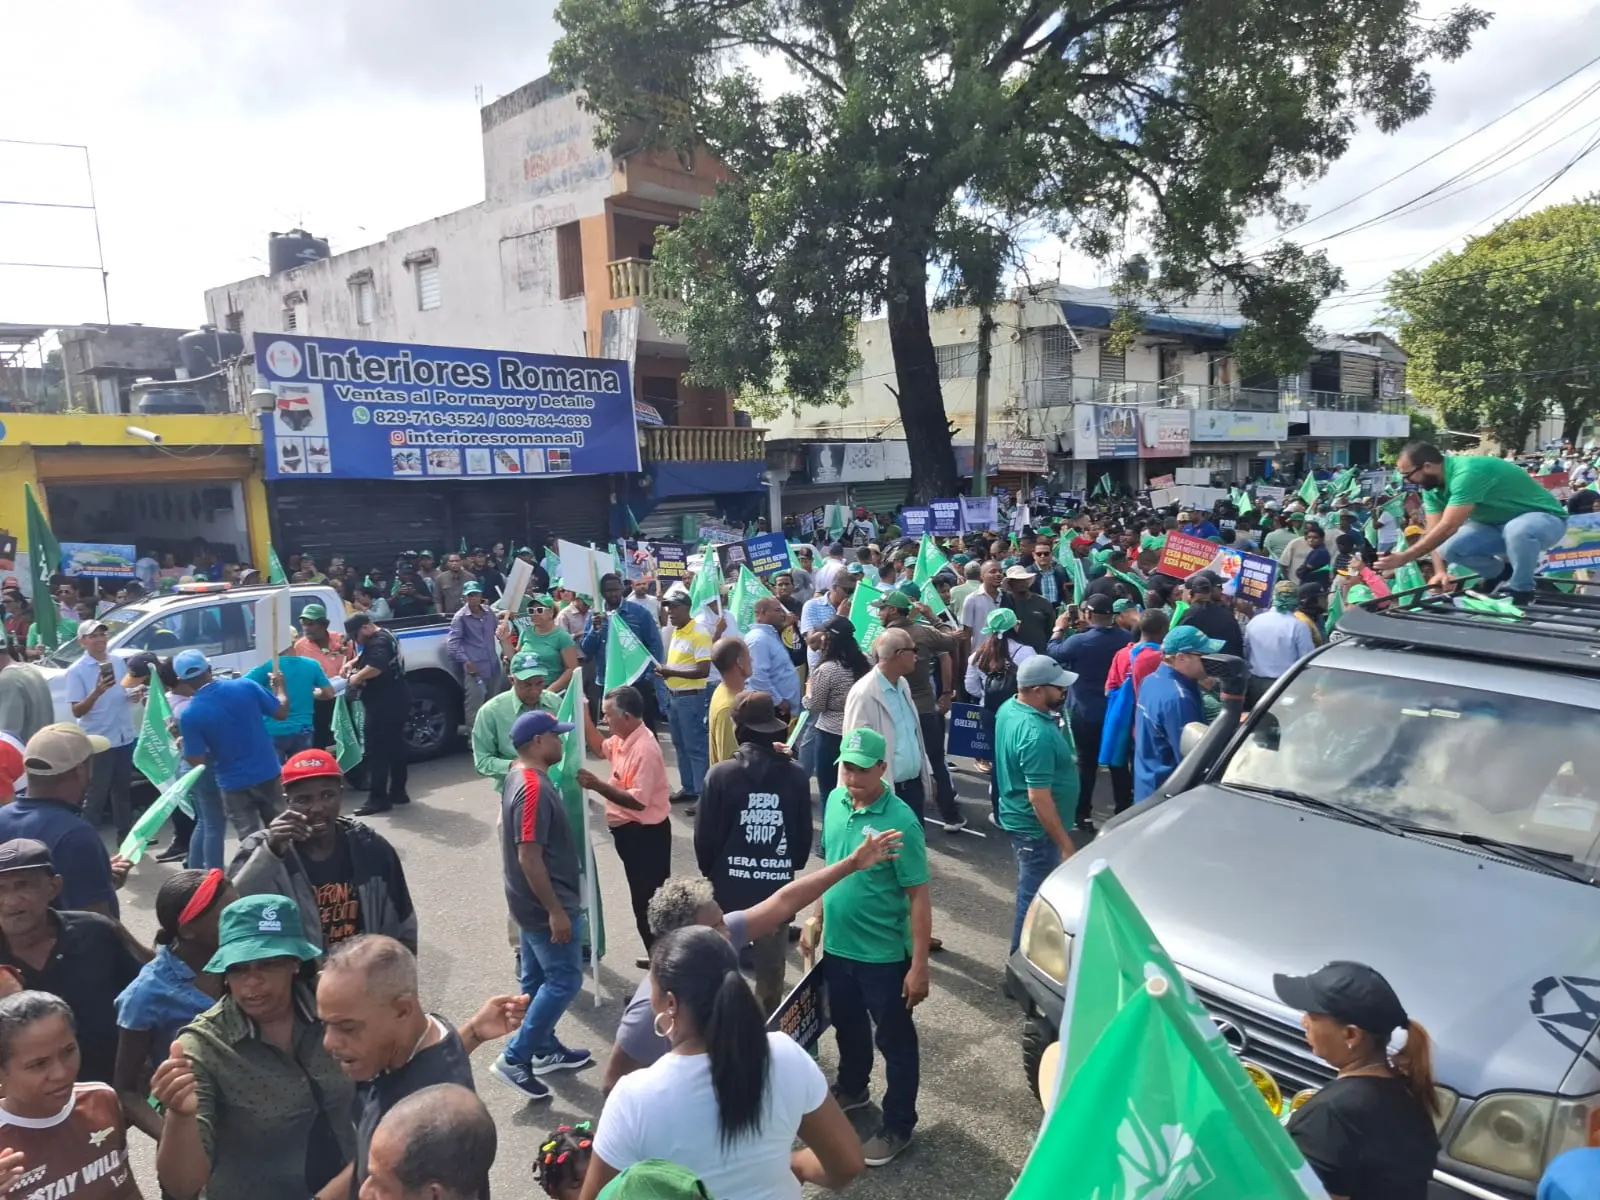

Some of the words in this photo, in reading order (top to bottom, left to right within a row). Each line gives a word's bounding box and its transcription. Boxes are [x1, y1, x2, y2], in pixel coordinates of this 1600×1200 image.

[304, 342, 491, 388] Interiores
[498, 356, 621, 393] Romana
[333, 384, 406, 403] Ventas
[412, 390, 429, 404] al
[435, 391, 465, 406] Por
[470, 394, 525, 409] mayor
[525, 397, 536, 409] y
[539, 395, 595, 409] Detalle
[374, 410, 485, 427] 829-716-3524
[498, 413, 592, 428] 809-784-4693
[406, 430, 584, 448] interioresromanaalj
[748, 792, 780, 809] BEBO
[745, 825, 777, 845] SHOP
[727, 856, 757, 868] 1ERA
[760, 858, 792, 868] GRAN
[728, 868, 751, 879] RIFA
[753, 871, 791, 881] OFICIAL
[82, 1149, 120, 1185] WILD
